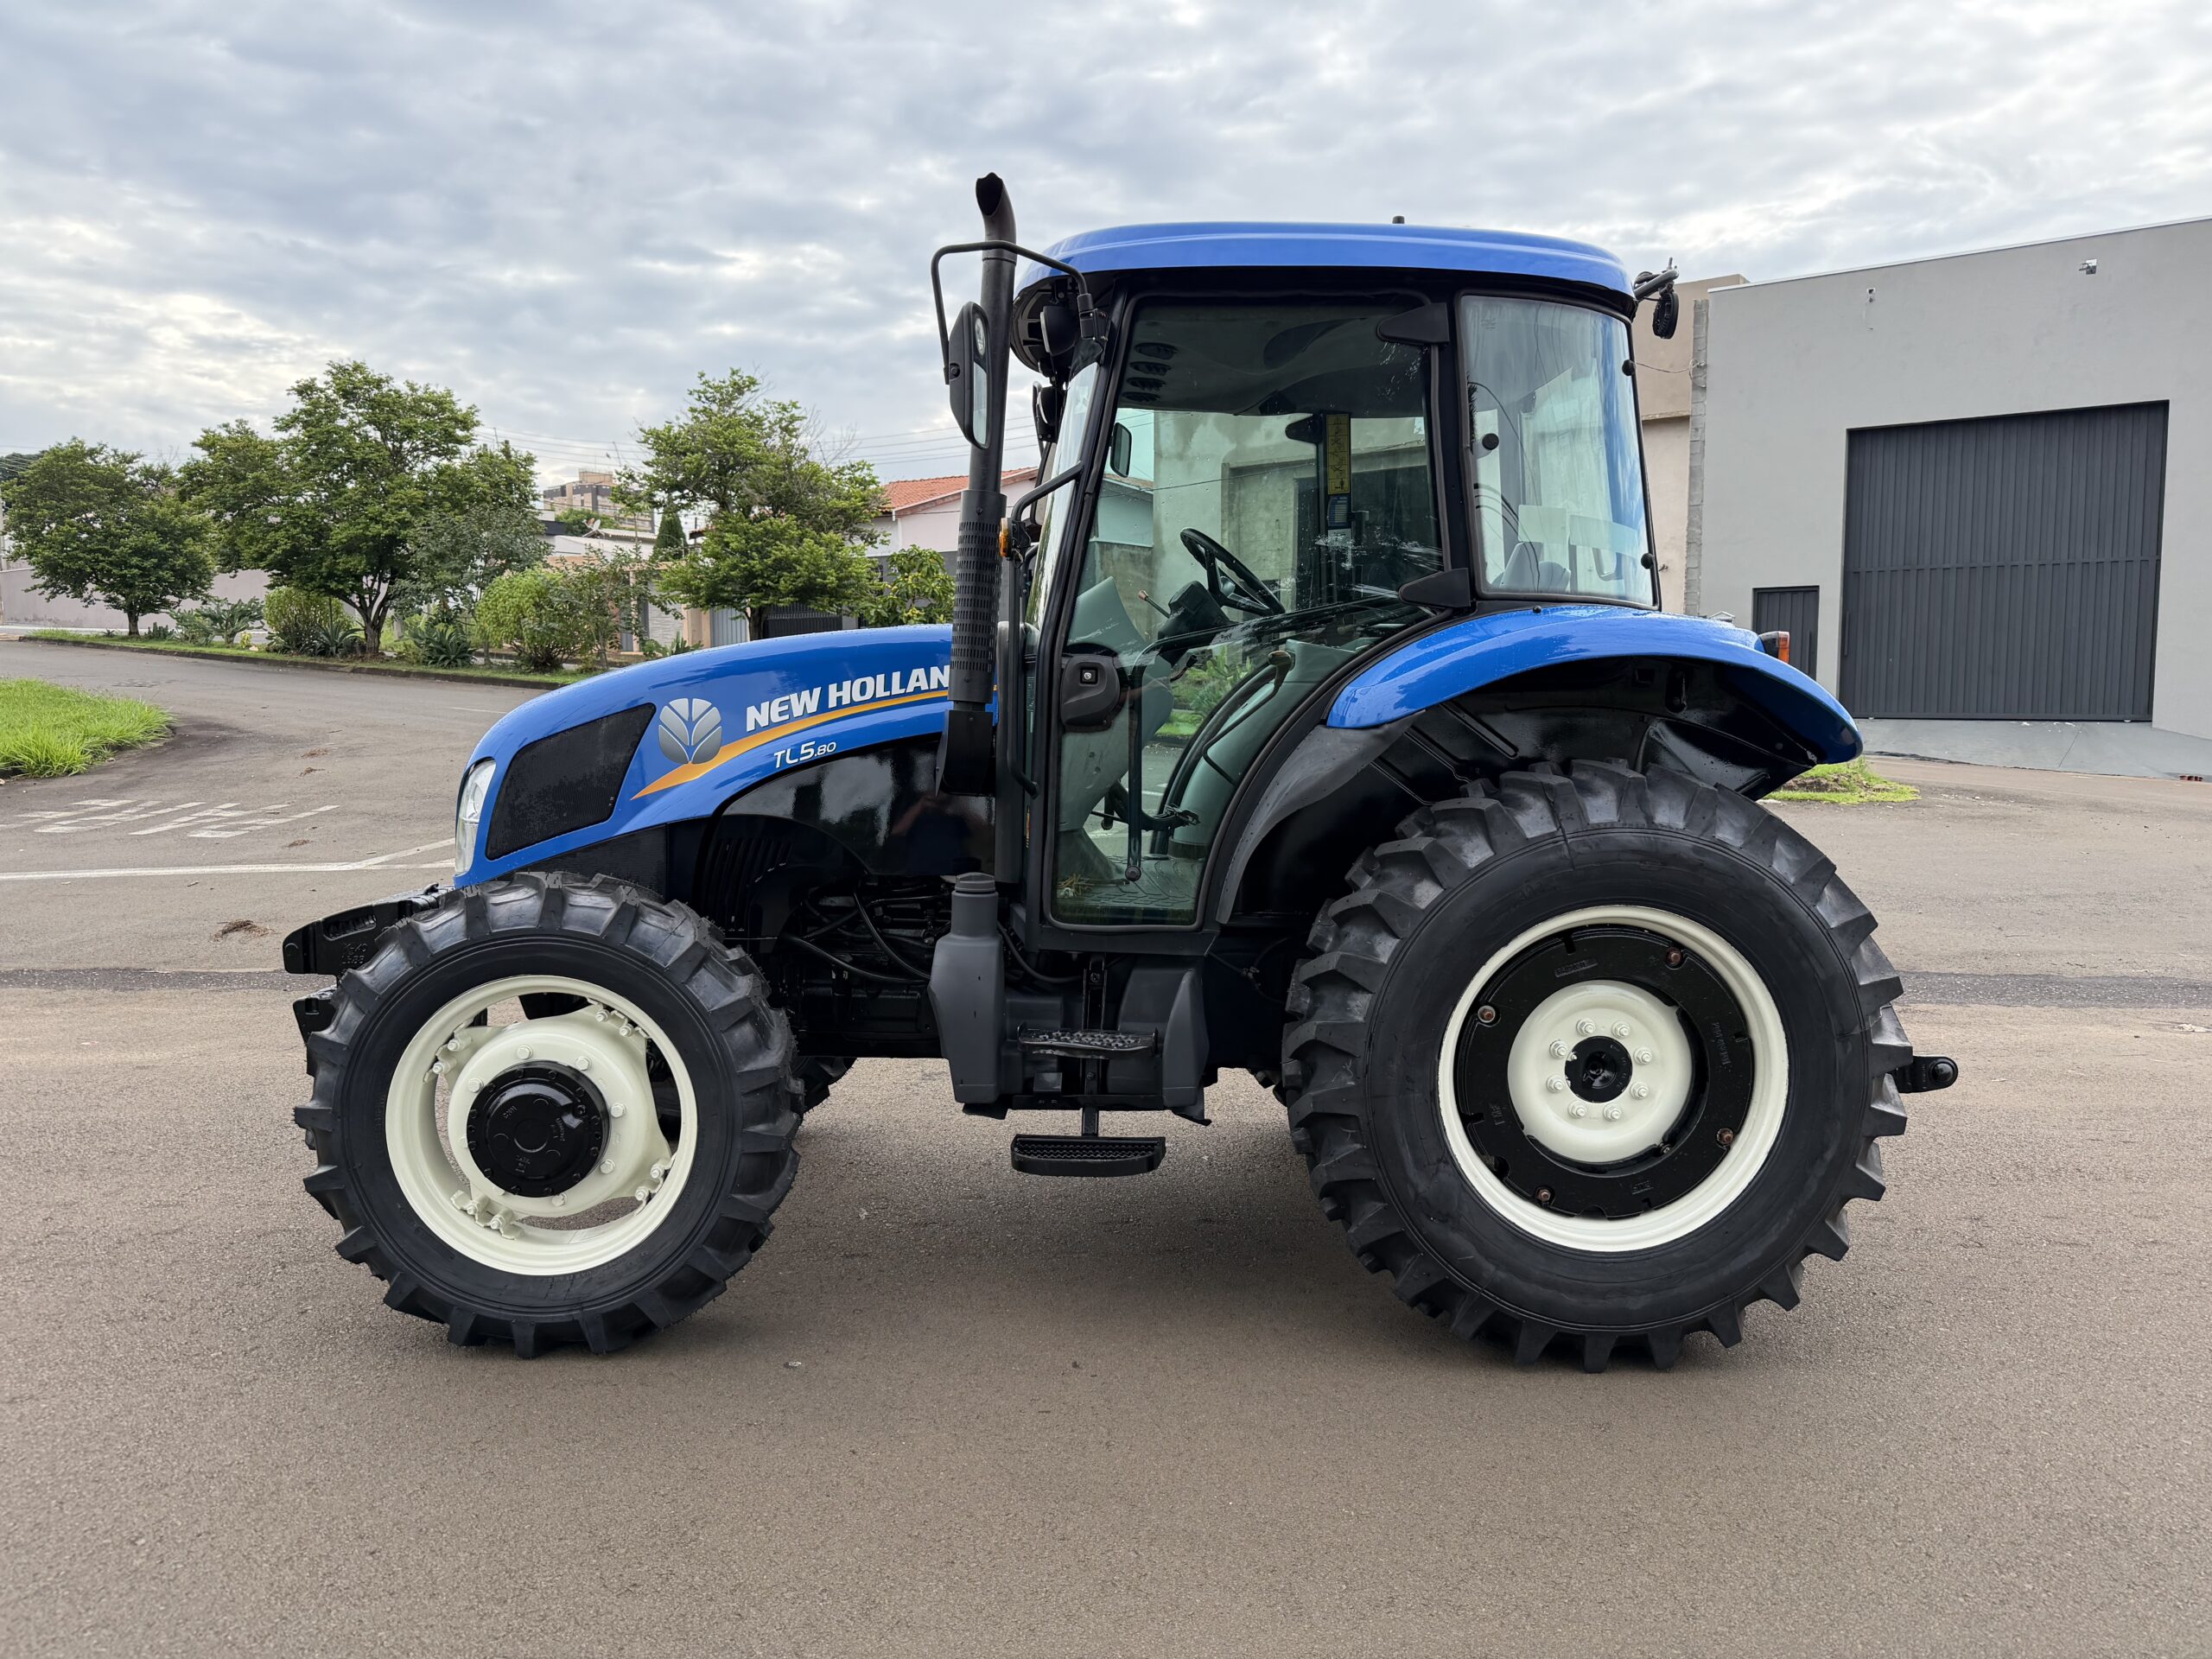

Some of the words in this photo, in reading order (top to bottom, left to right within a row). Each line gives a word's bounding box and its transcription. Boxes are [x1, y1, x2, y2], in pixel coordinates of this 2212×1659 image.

[746, 686, 822, 732] NEW
[828, 664, 950, 709] HOLLAN
[773, 741, 837, 769] TL5.80
